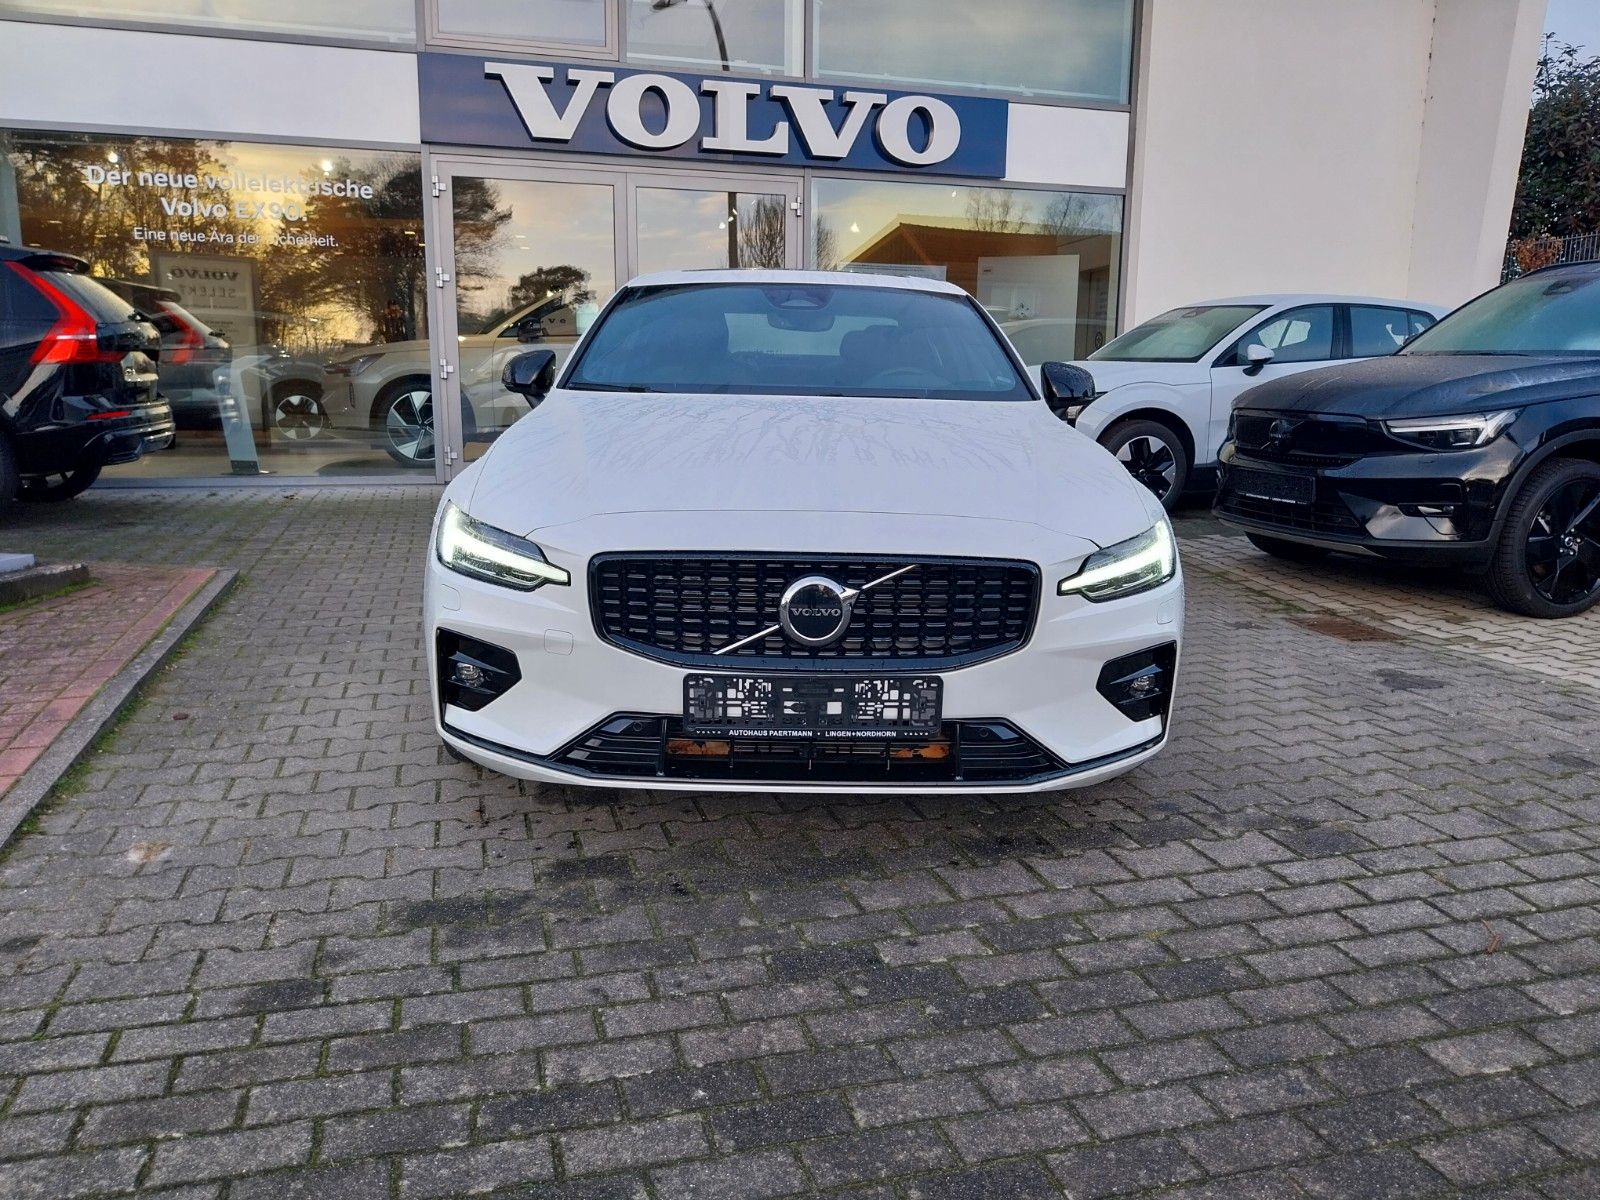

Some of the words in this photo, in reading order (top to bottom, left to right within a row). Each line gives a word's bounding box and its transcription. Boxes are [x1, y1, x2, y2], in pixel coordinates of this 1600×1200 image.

[484, 61, 962, 166] VOLVO
[86, 165, 132, 186] Der
[138, 171, 198, 189] neue
[160, 196, 227, 218] Volvo
[235, 200, 308, 222] EX90.
[133, 226, 166, 241] Eine
[170, 230, 206, 243] neue
[209, 225, 234, 244] Ära
[265, 231, 339, 248] icherheit.
[790, 607, 842, 617] VOLVO
[728, 729, 768, 737] AUTOHAUS
[769, 729, 813, 737] PAERTMANN
